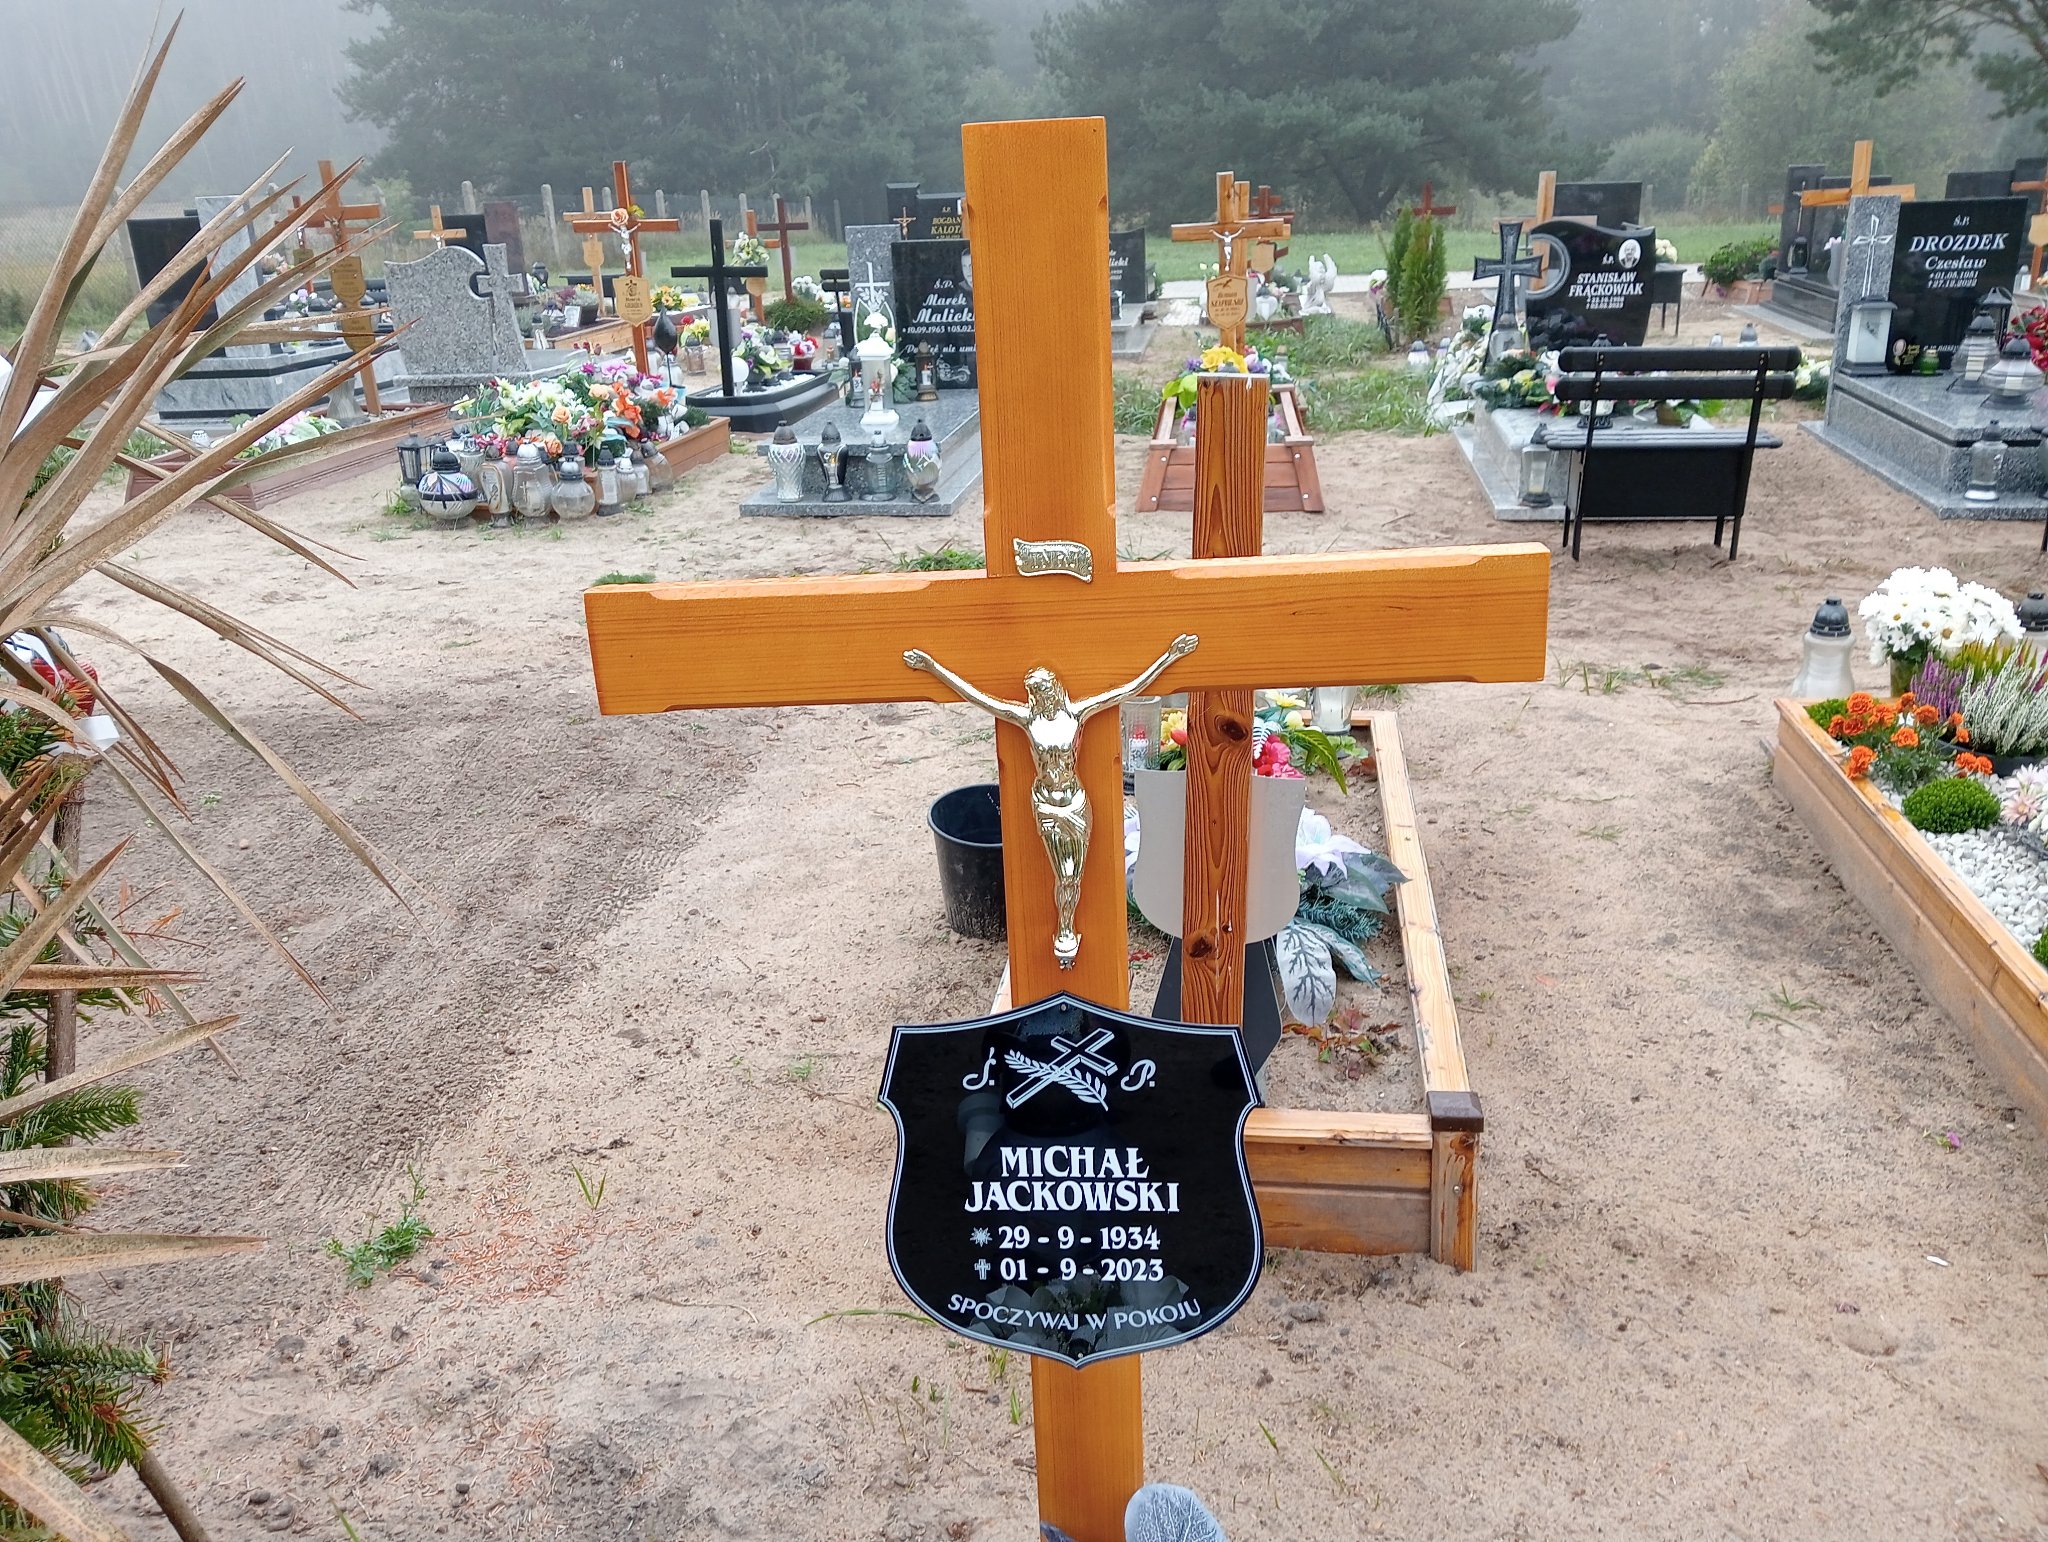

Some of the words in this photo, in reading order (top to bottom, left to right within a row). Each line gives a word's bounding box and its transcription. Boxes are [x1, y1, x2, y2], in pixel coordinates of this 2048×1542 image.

[1908, 232, 2010, 252] DROZDEK
[923, 293, 968, 306] Marek
[1000, 1145, 1150, 1180] MICHAŁ
[964, 1180, 1180, 1214] JACKOWSKI
[947, 1293, 1079, 1330] SPOCZYWAJ
[1085, 1313, 1107, 1330] W
[1114, 1298, 1201, 1329] POKOJU
